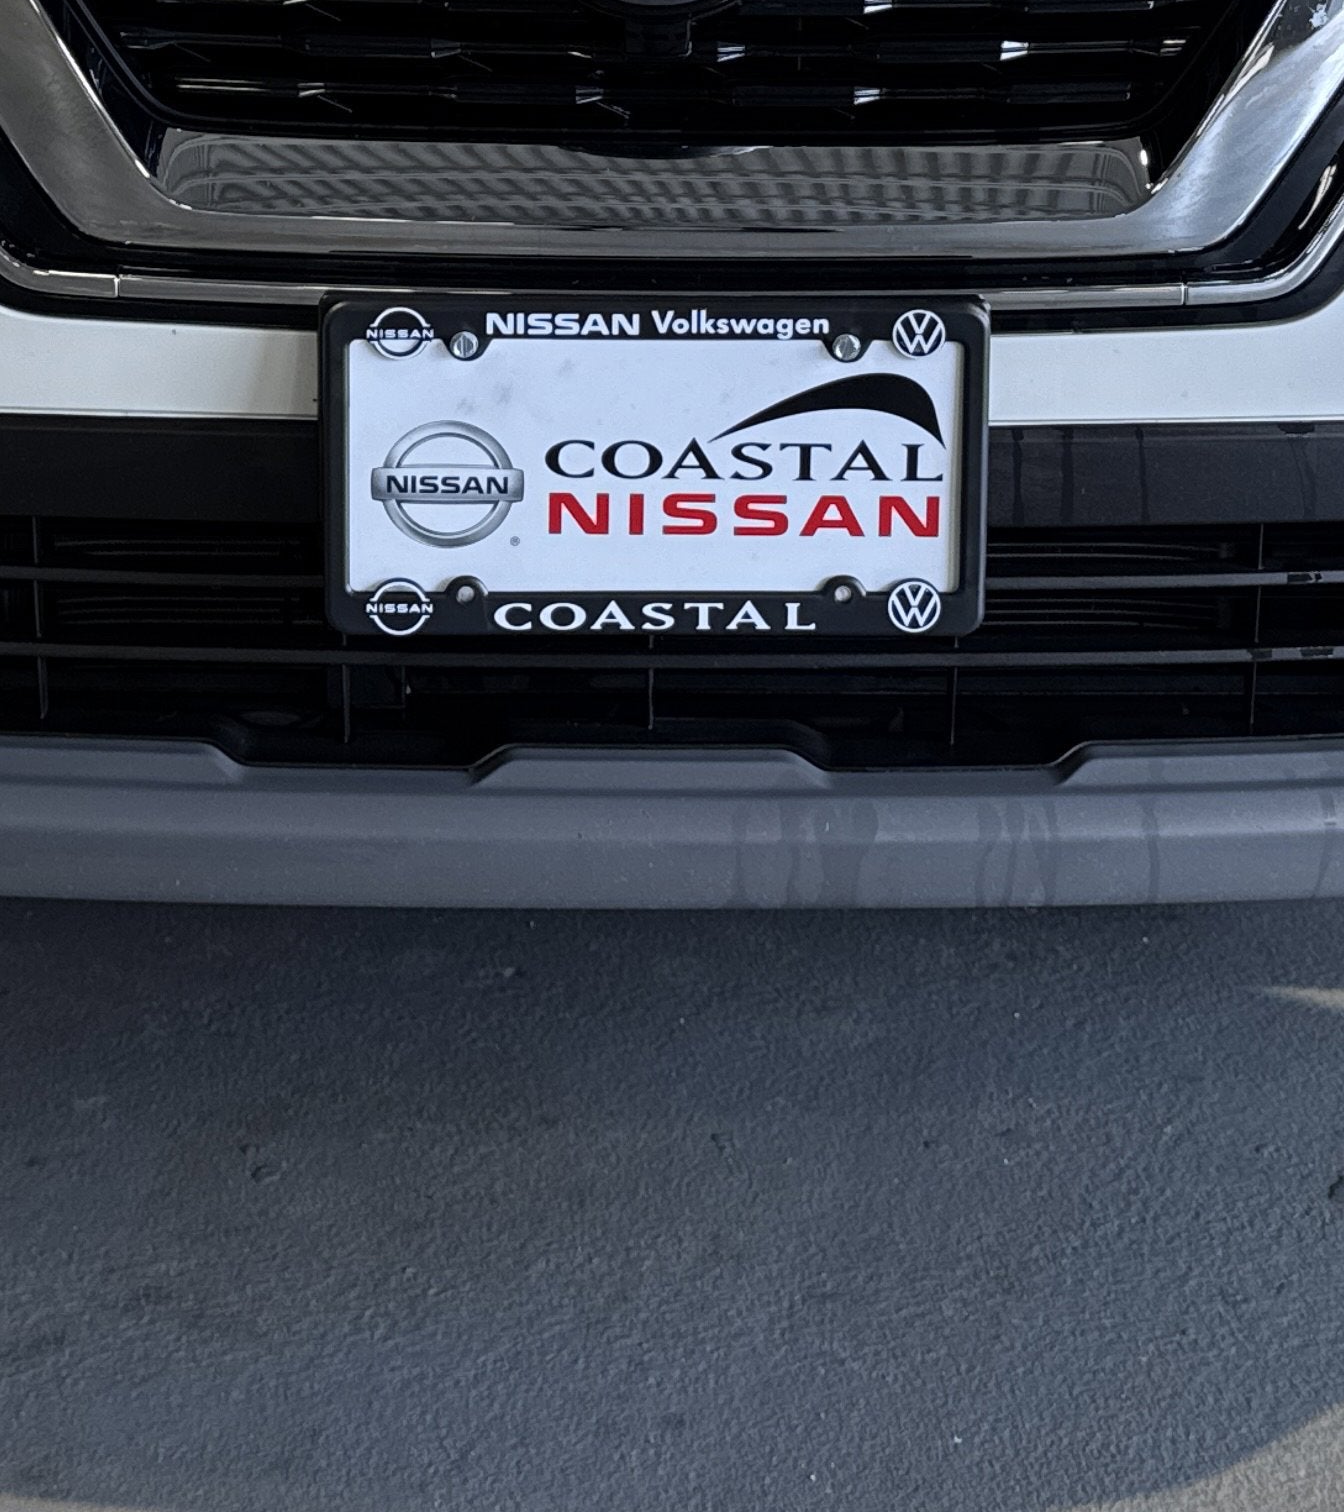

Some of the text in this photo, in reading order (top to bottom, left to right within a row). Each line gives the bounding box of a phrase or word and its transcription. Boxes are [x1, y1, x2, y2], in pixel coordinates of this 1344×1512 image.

[366, 328, 434, 339] NISSAN
[486, 310, 830, 339] NISSAN Volkswagen
[544, 436, 945, 482] COASTAL
[385, 473, 510, 495] NISSAN
[547, 492, 941, 538] NISSAN
[366, 602, 434, 614] NISSAN
[493, 599, 817, 631] COASTAL
